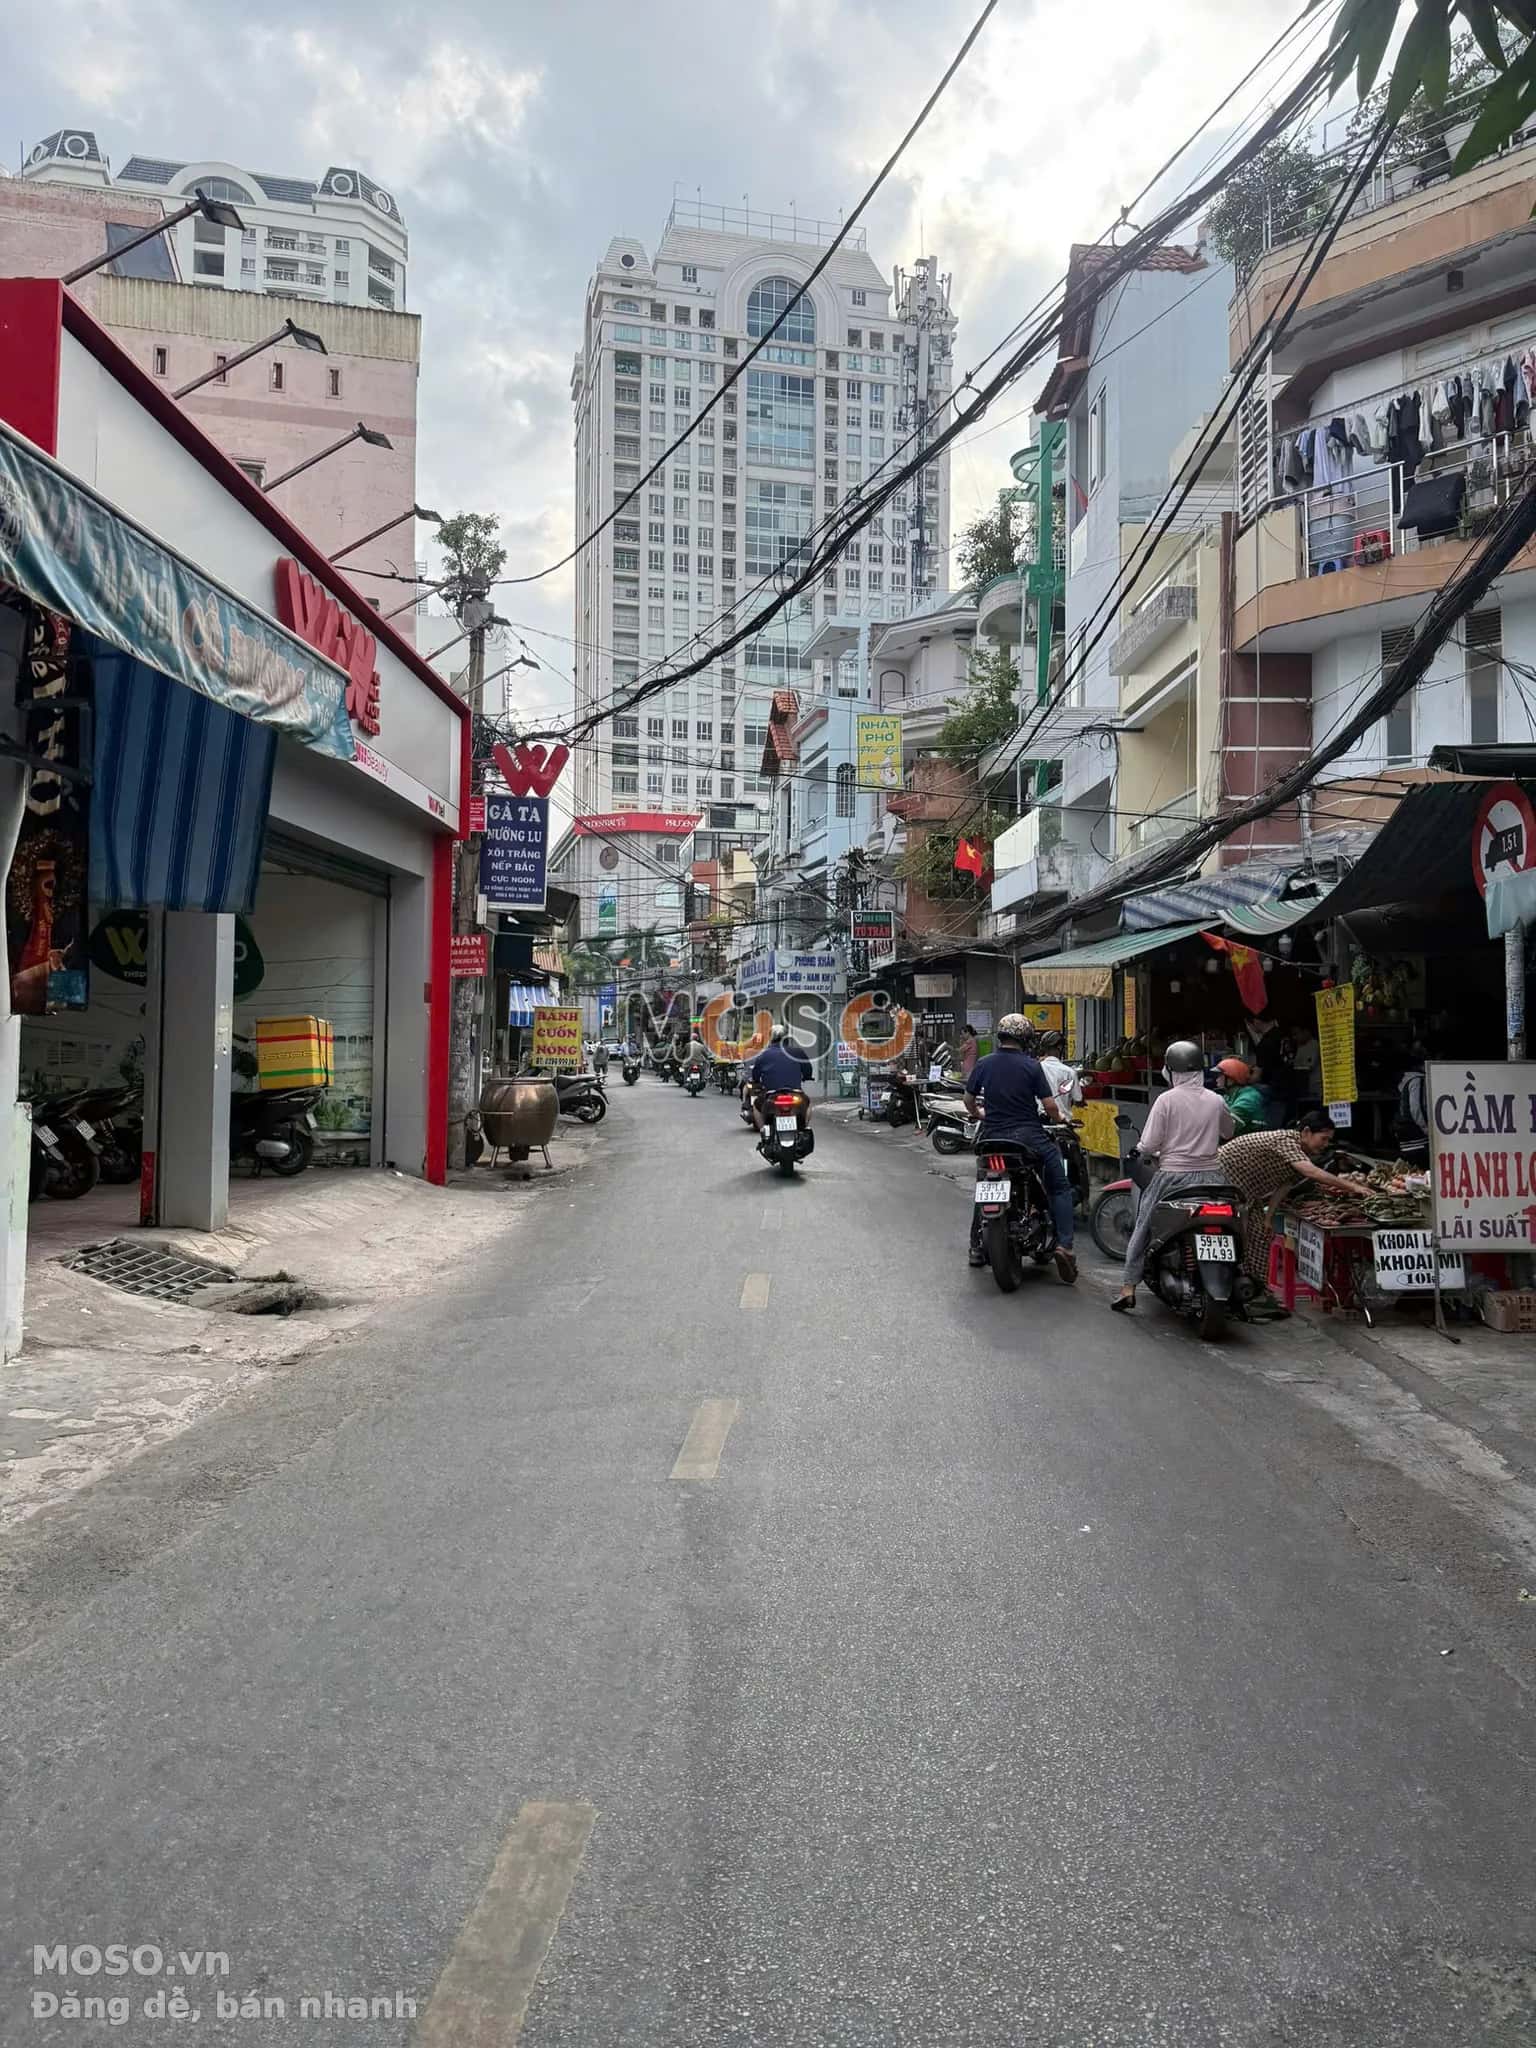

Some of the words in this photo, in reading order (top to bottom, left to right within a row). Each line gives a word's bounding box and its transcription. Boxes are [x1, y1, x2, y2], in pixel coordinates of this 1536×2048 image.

[489, 801, 513, 822] GÀ
[518, 806, 541, 823] TA
[528, 830, 542, 843] LU
[1434, 1070, 1517, 1135] CẦM
[1438, 1151, 1510, 1209] HẠNH
[1441, 1215, 1472, 1239] LÃI
[1479, 1211, 1530, 1239] SUẤT
[1377, 1232, 1419, 1250] KHOAI
[1380, 1253, 1433, 1271] KHOAI
